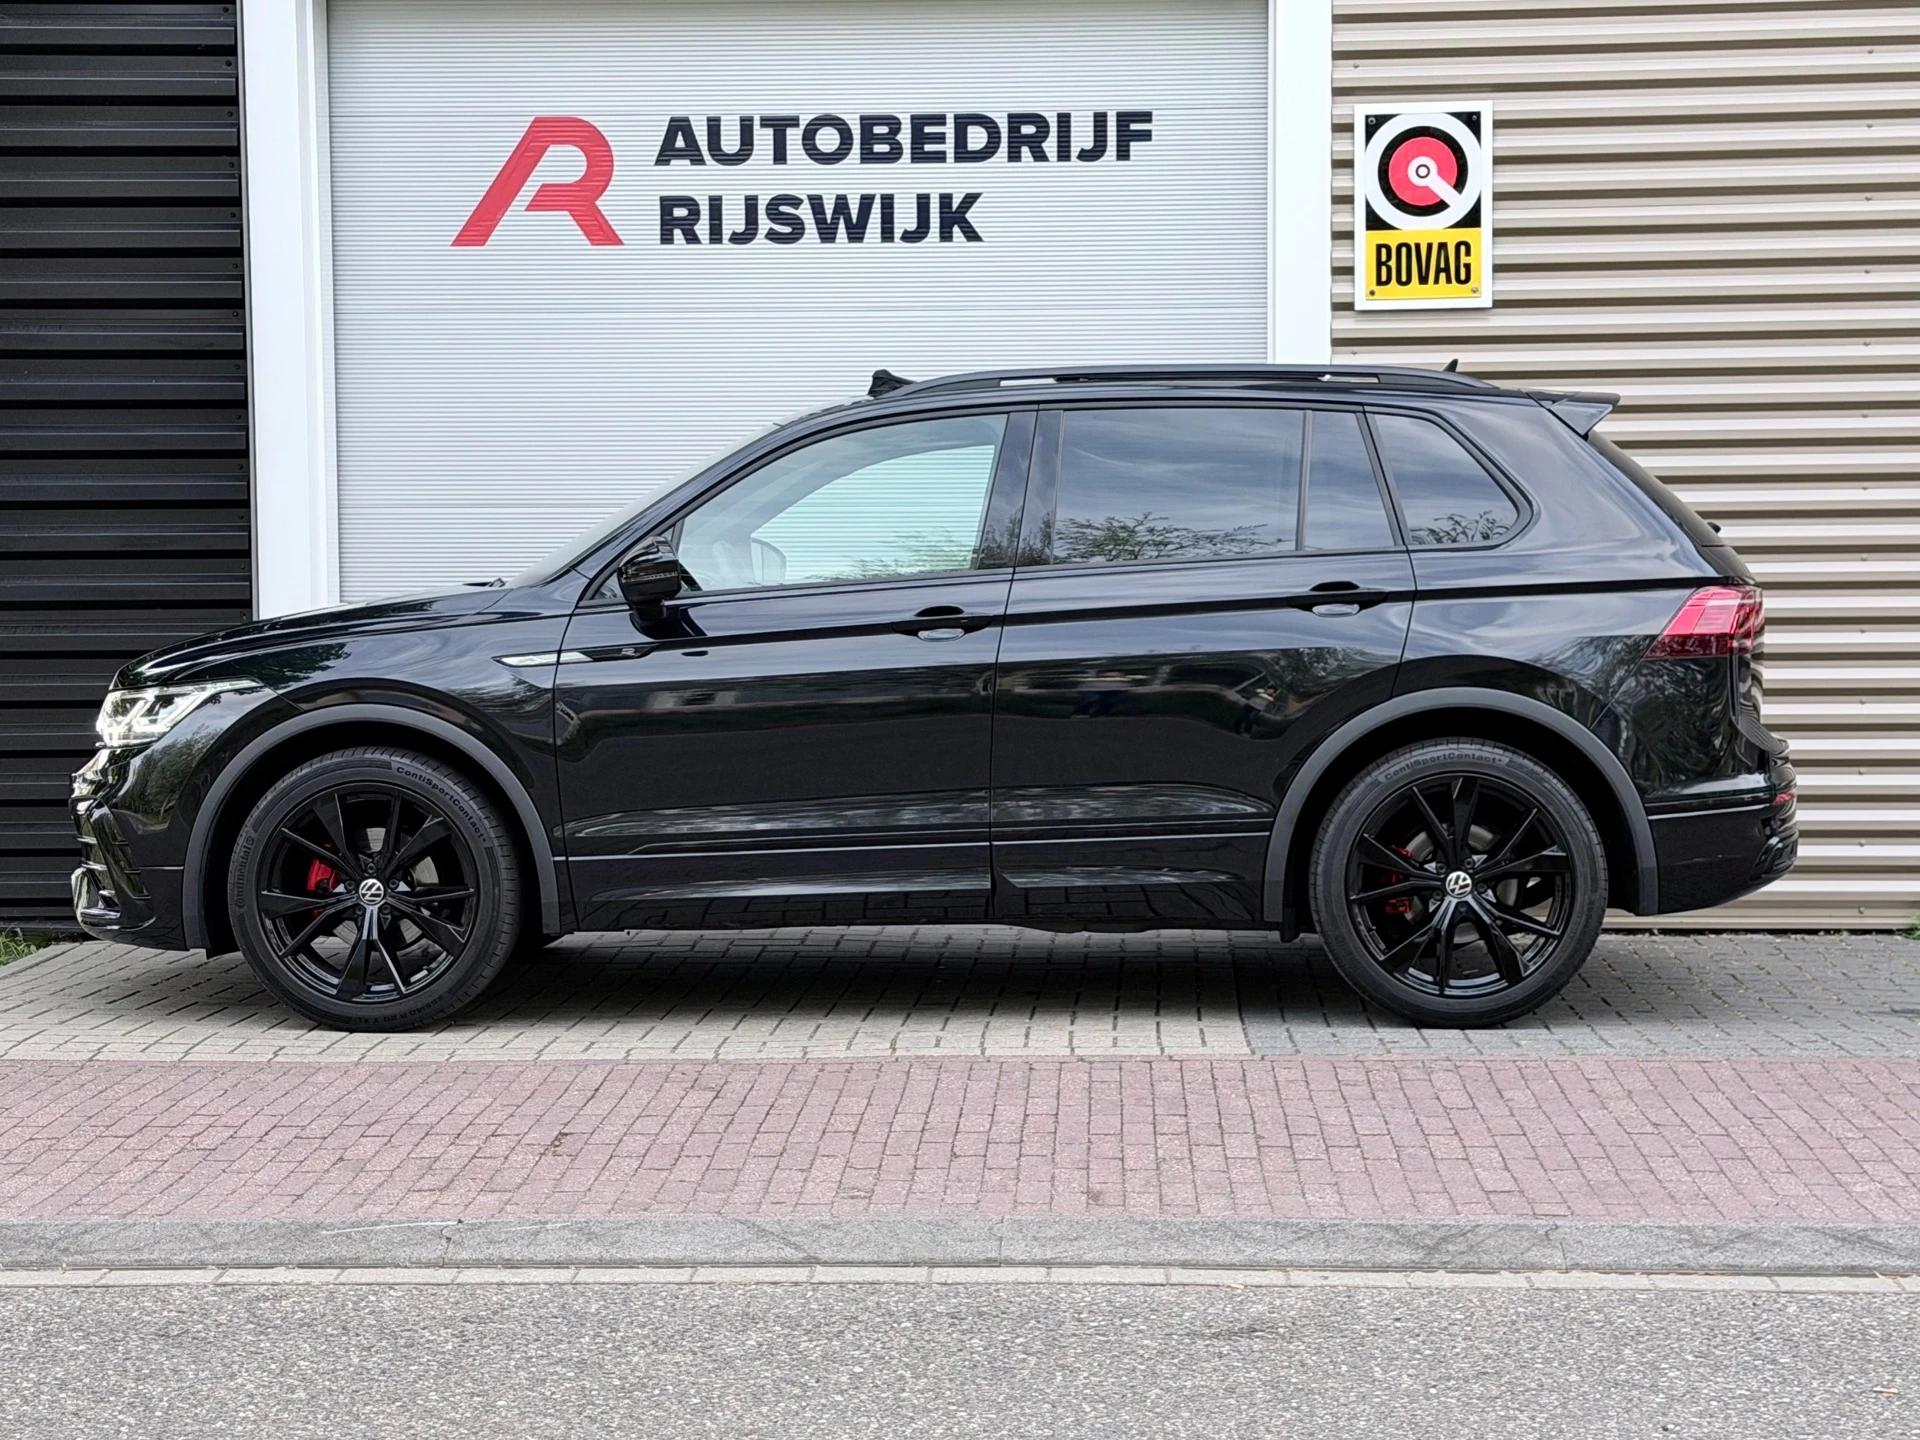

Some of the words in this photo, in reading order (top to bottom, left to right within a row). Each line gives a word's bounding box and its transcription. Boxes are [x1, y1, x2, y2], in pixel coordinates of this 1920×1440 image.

[654, 111, 1153, 166] AUTOBEDRIJF
[659, 193, 985, 245] RIJSWIJK
[1375, 241, 1472, 286] BOVAG
